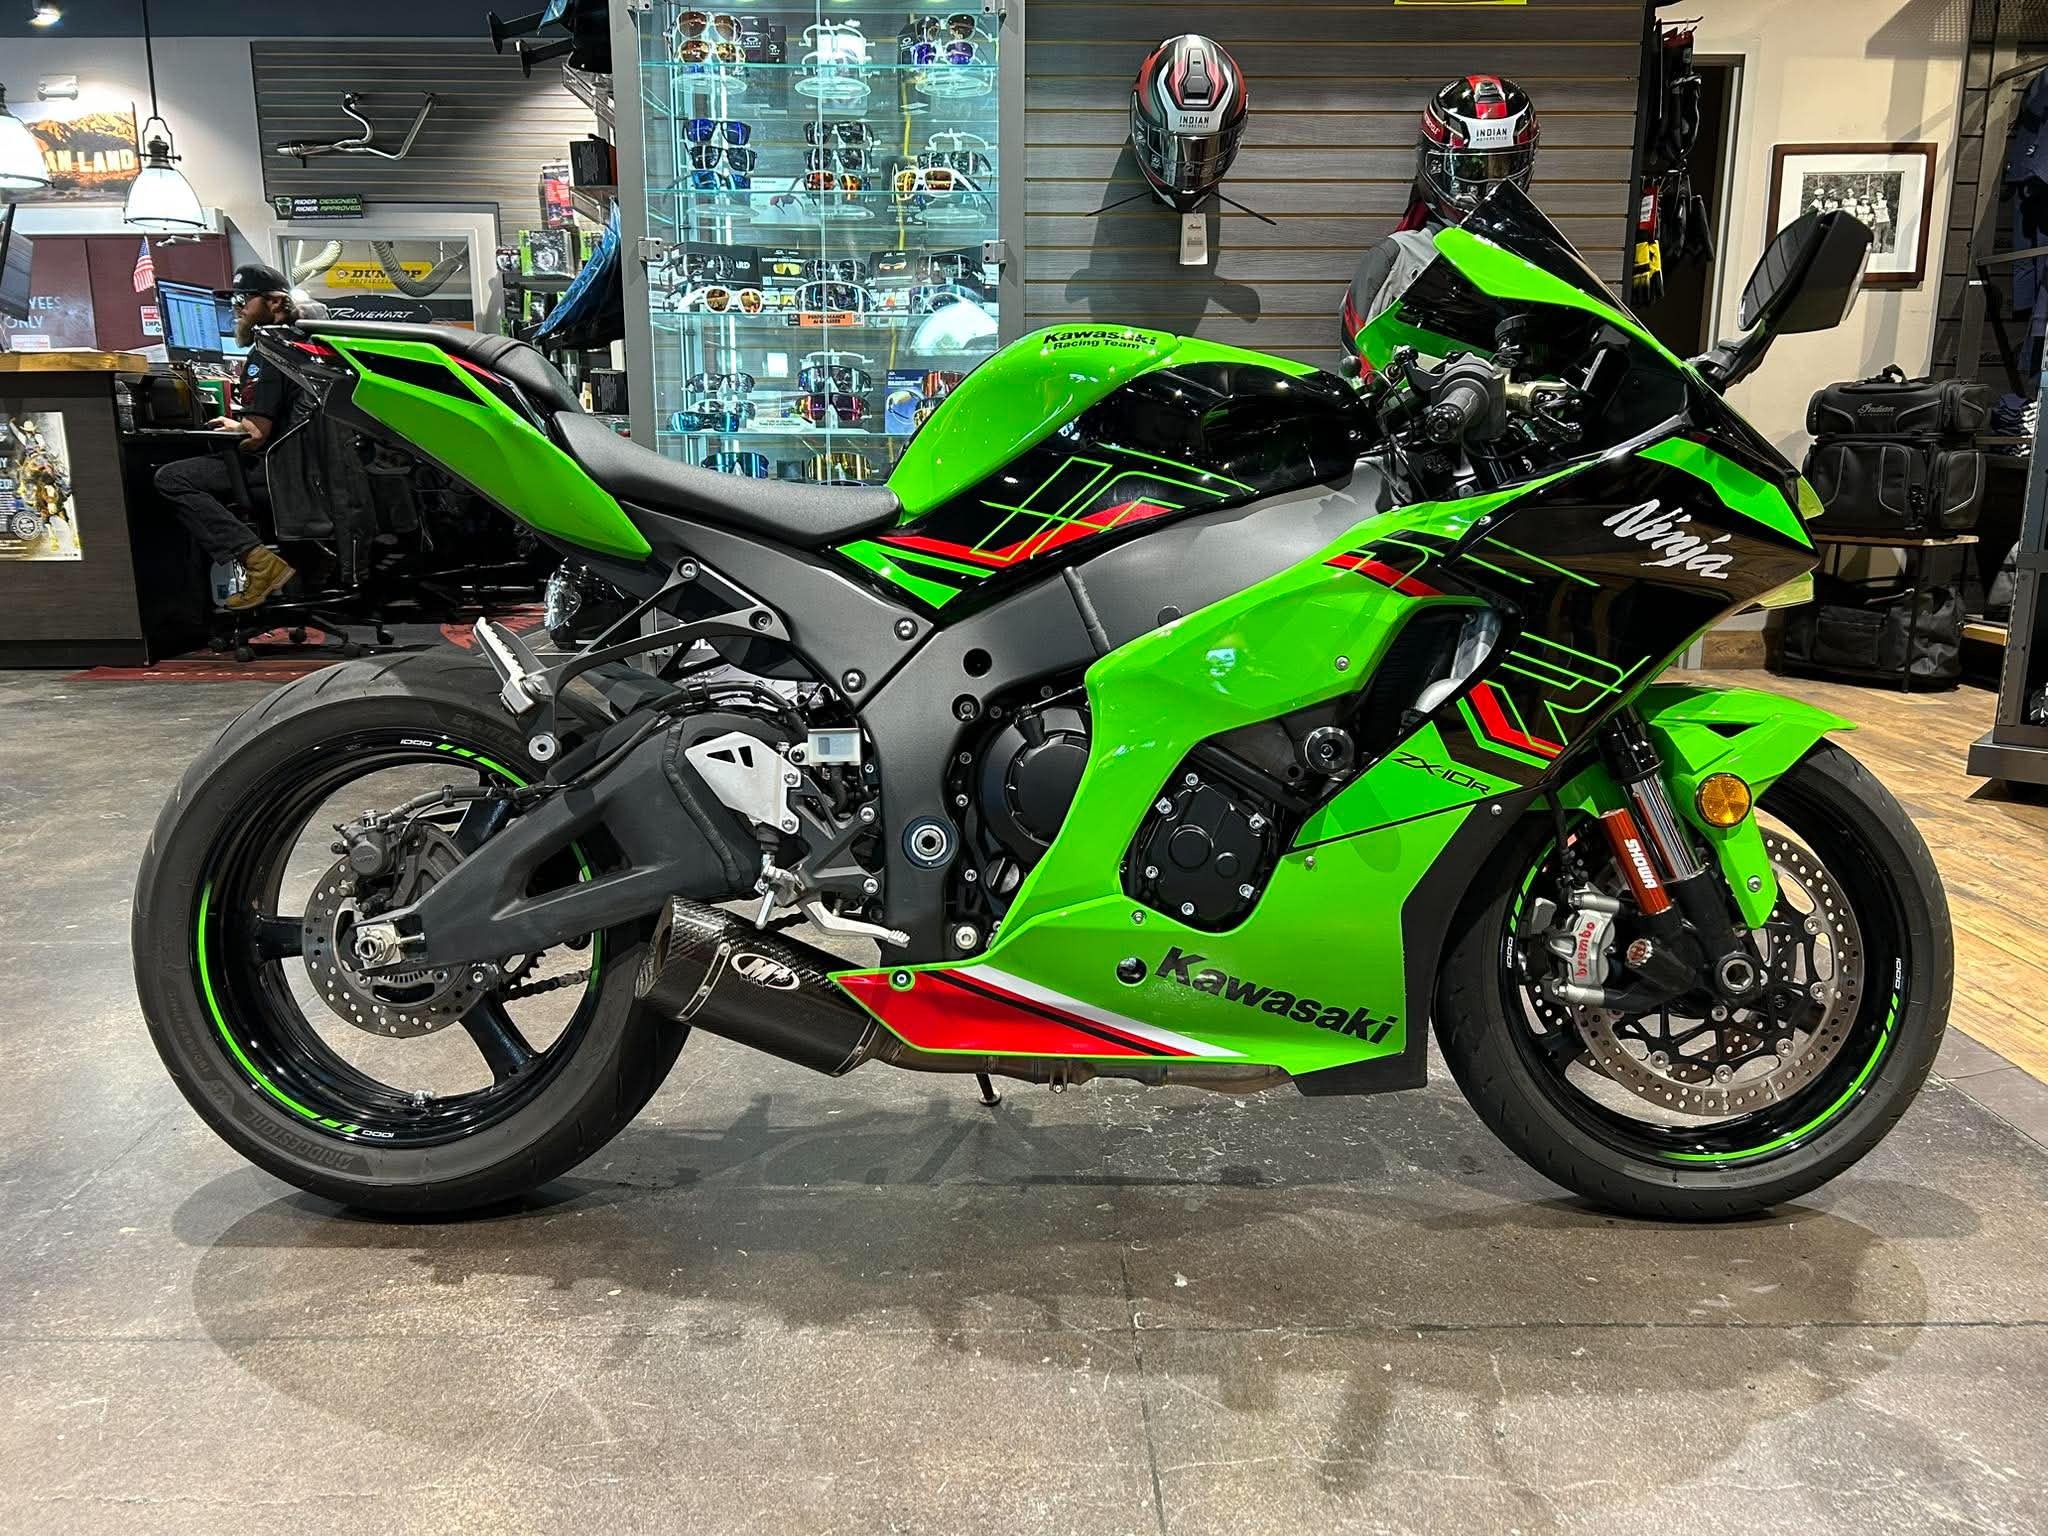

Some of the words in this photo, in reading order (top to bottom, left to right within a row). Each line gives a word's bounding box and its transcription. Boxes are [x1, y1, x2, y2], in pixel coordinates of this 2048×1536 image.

[1179, 116, 1210, 124] INDIAN
[1476, 128, 1508, 137] INDIAN
[77, 148, 135, 174] LAND
[327, 307, 415, 319] RINEHART
[1043, 330, 1158, 346] Kawasaki
[1053, 339, 1100, 350] Racing
[1103, 339, 1141, 350] Team
[1602, 498, 1734, 580] Ninja
[400, 739, 433, 747] 1000
[1391, 752, 1492, 796] ZX-10R
[1623, 838, 1659, 889] SHOWA
[1574, 921, 1596, 978] brembo
[1154, 946, 1399, 1045] Kawasaki
[243, 1107, 354, 1171] BRIDGESTONE
